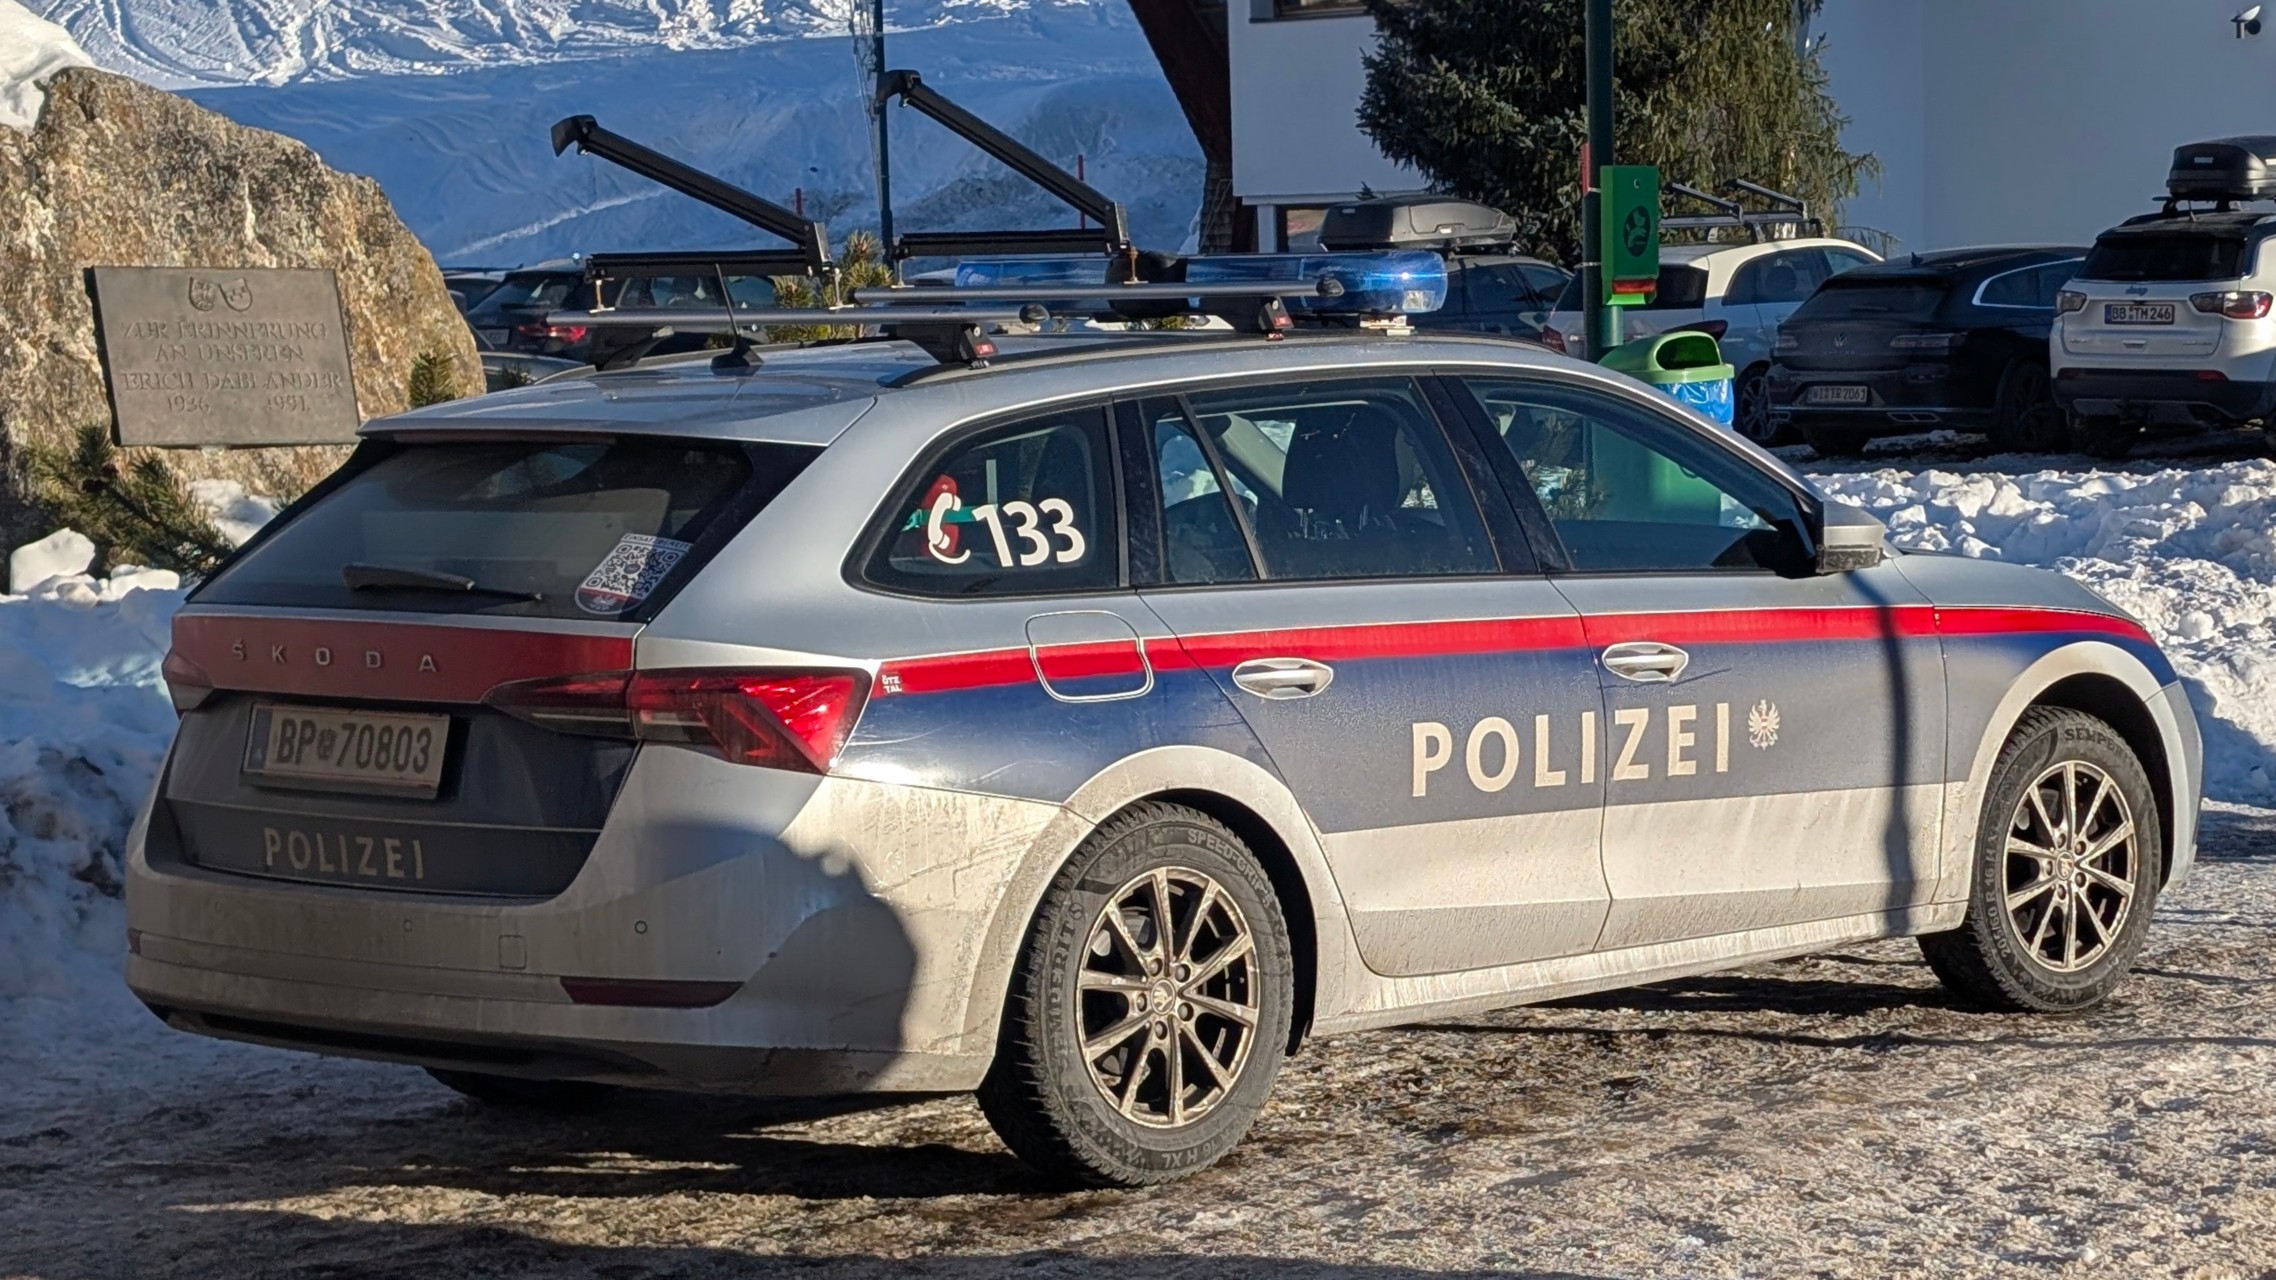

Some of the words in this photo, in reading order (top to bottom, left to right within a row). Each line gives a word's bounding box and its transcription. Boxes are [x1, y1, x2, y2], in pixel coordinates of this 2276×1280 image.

[2112, 307, 2126, 320] BB
[2135, 307, 2149, 320] TM
[2150, 307, 2171, 320] 246
[124, 321, 169, 339] ZUR
[176, 320, 328, 340] ERINNERUNG
[155, 343, 188, 362] AN
[199, 343, 305, 362] UNSEREN
[121, 371, 195, 391] ERICH
[971, 497, 1086, 568] 133
[231, 639, 438, 673] ŠKODA
[883, 684, 903, 694] TAL
[275, 717, 317, 766] BP
[335, 722, 433, 775] 70803
[1412, 701, 1731, 798] POLIZEI
[263, 827, 424, 880] POLIZEI
[1187, 828, 1268, 895] SPEED-GRIP
[1984, 868, 1995, 886] 16
[1985, 890, 1996, 903] R
[1161, 1152, 1182, 1169] XL
[1186, 1148, 1198, 1164] H
